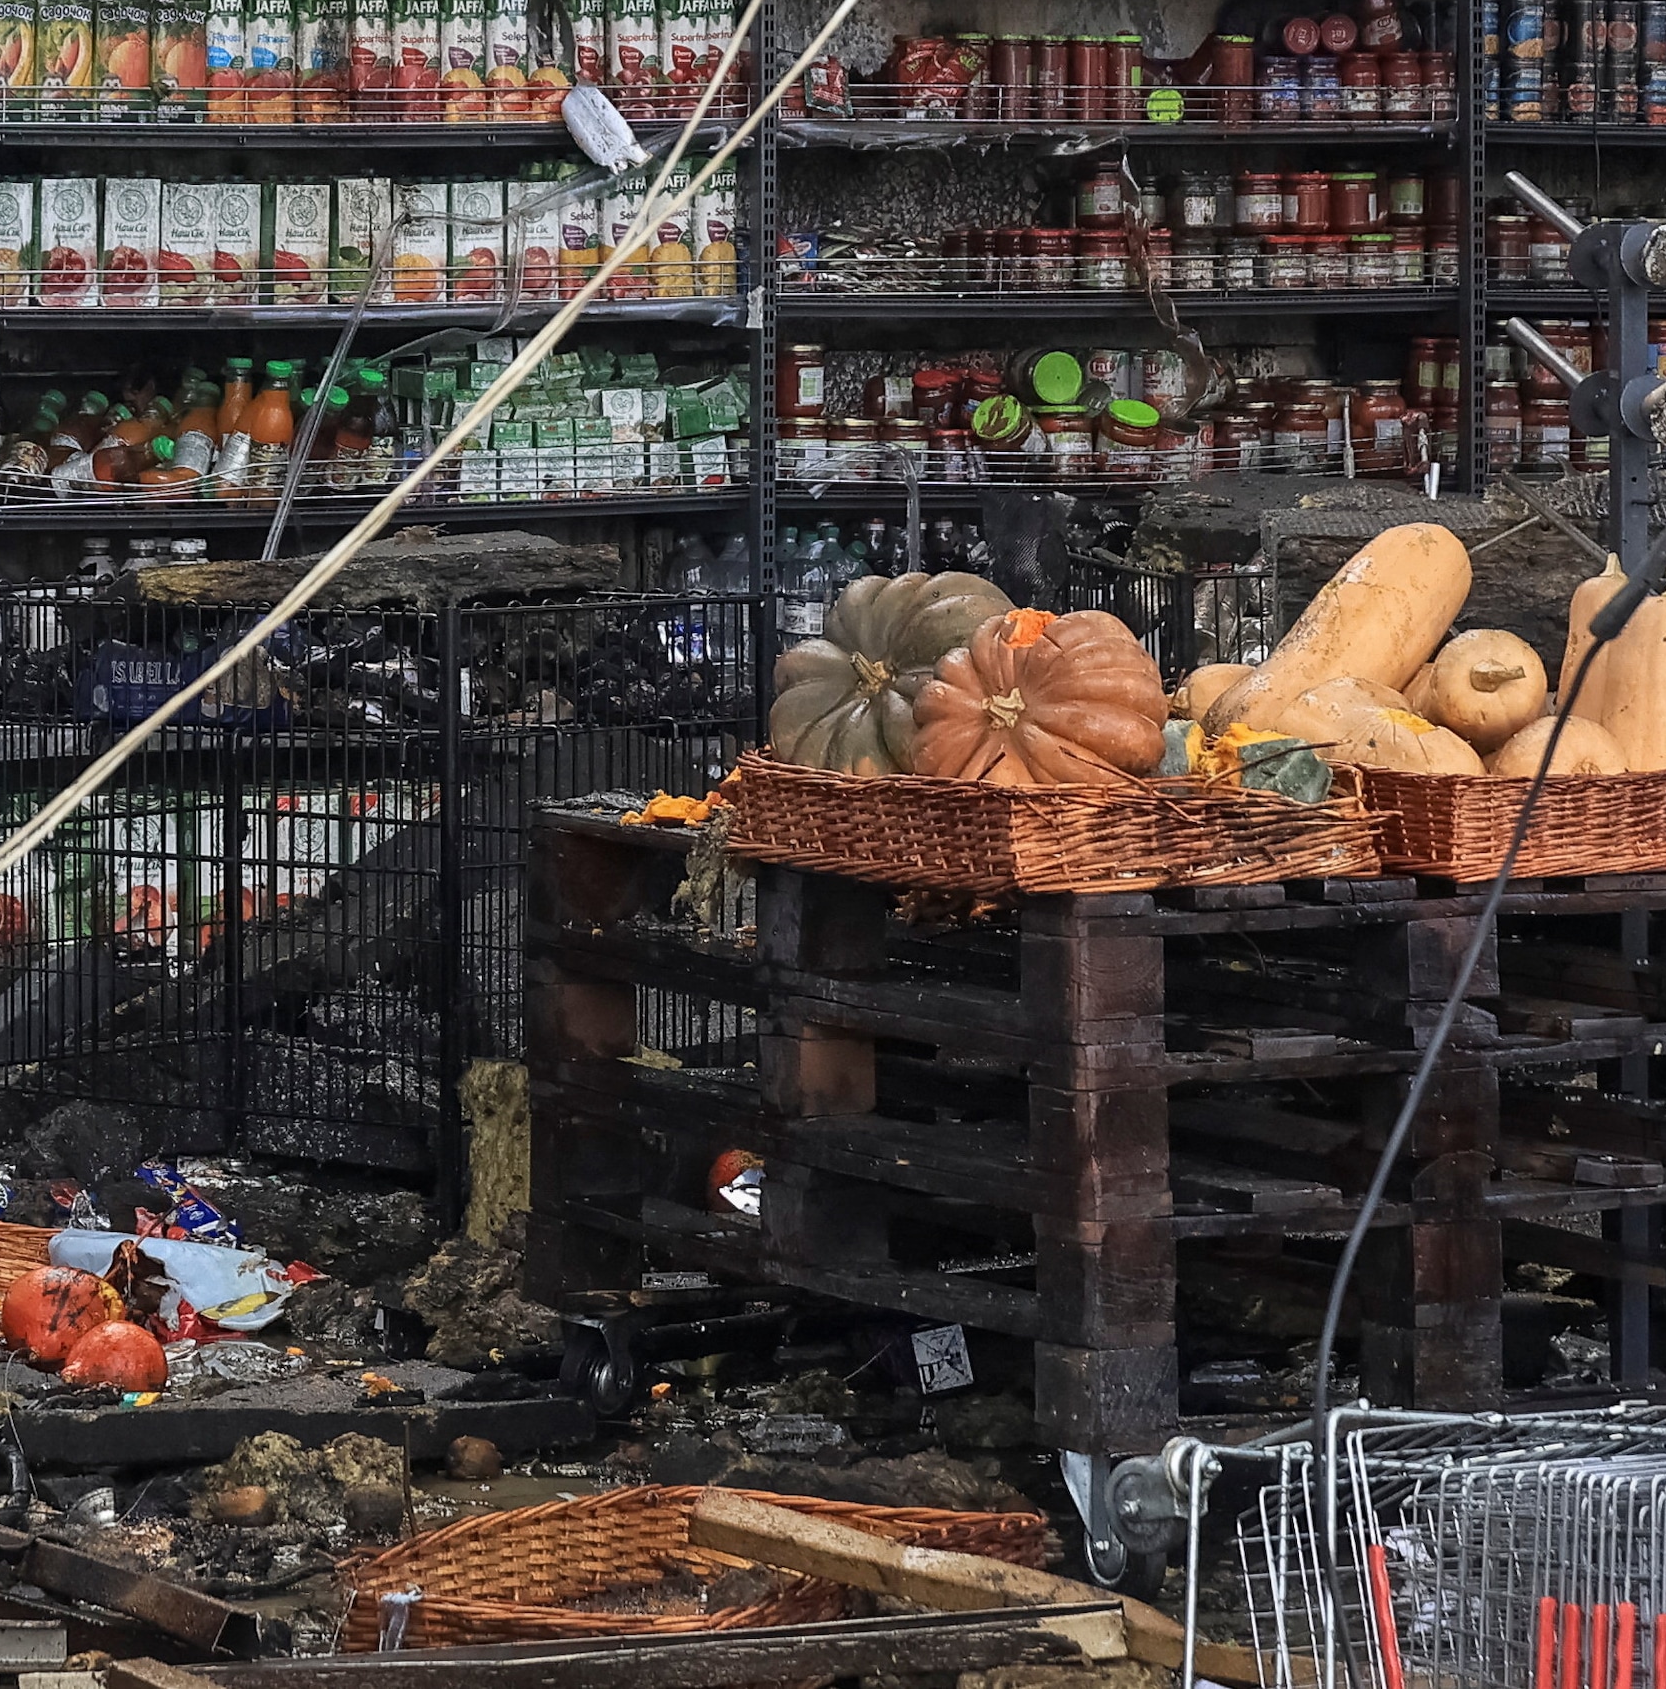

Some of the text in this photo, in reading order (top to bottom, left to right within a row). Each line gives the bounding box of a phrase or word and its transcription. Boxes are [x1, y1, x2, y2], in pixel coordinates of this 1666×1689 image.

[40, 5, 91, 21] Садочок
[451, 0, 485, 14] JAFFA
[457, 33, 482, 44] Selec
[501, 31, 527, 42] Selec
[1091, 359, 1112, 375] tat
